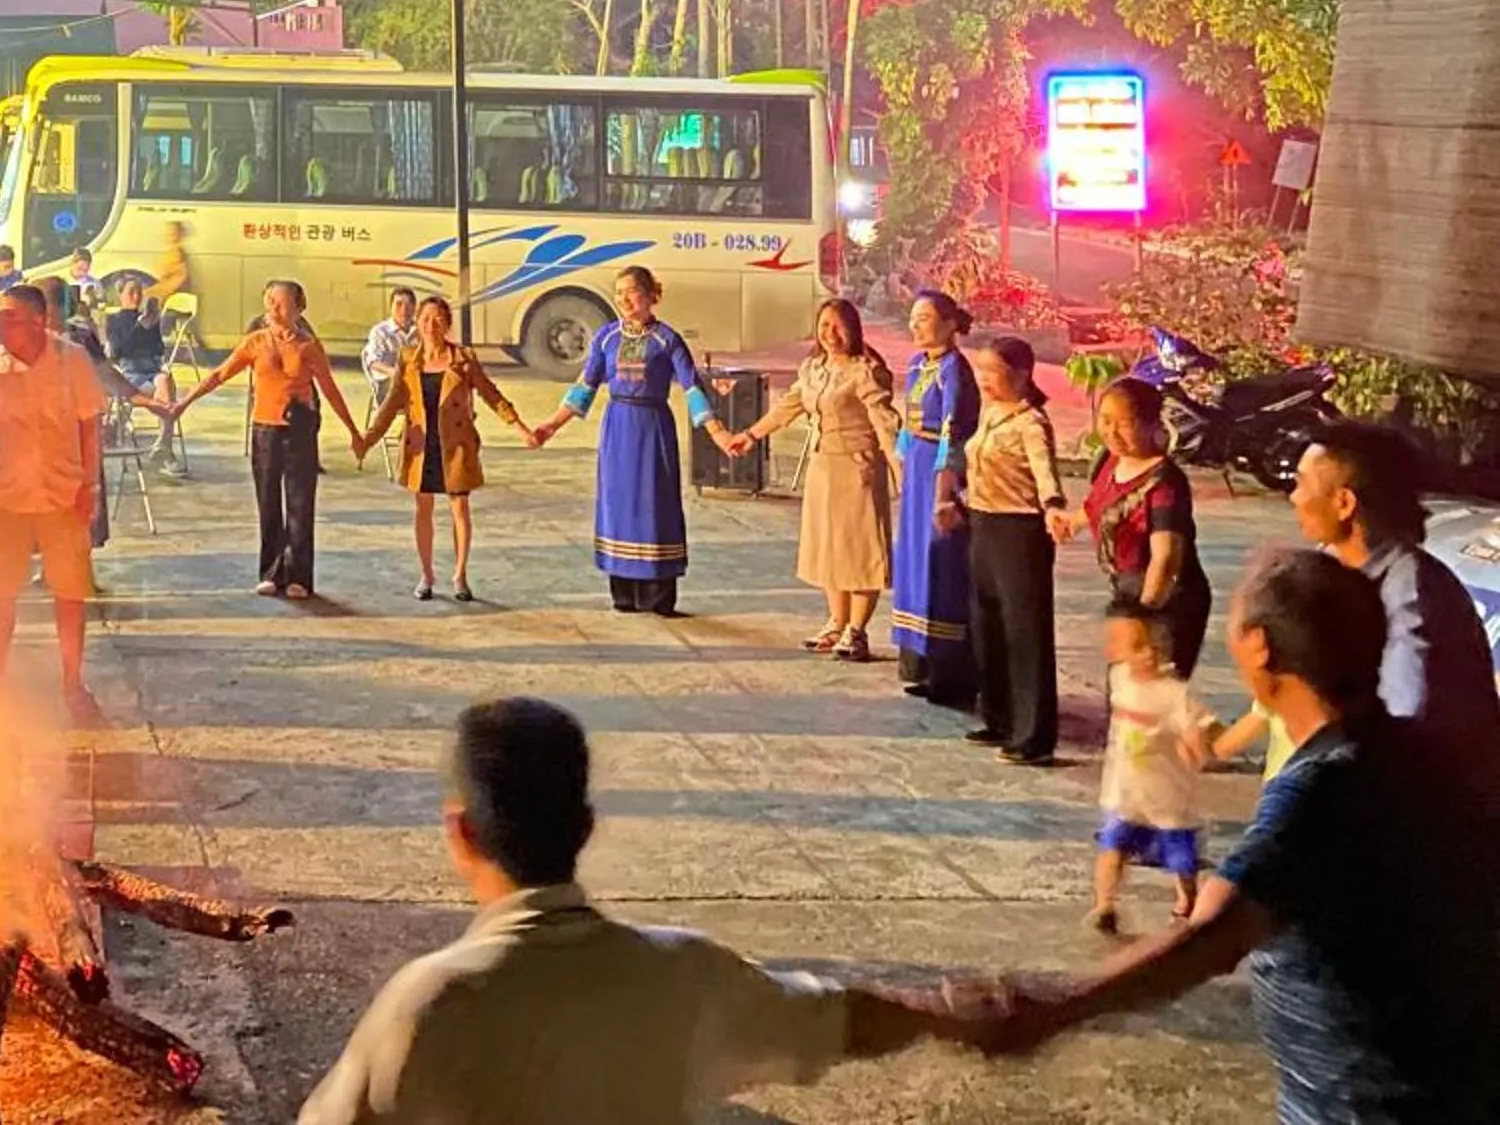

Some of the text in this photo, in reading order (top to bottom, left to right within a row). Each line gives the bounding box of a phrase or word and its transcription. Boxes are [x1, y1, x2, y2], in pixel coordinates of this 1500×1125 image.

[243, 223, 372, 242] 환상적인 관광 버스
[673, 232, 707, 249] 20B
[724, 234, 782, 251] 028.99
